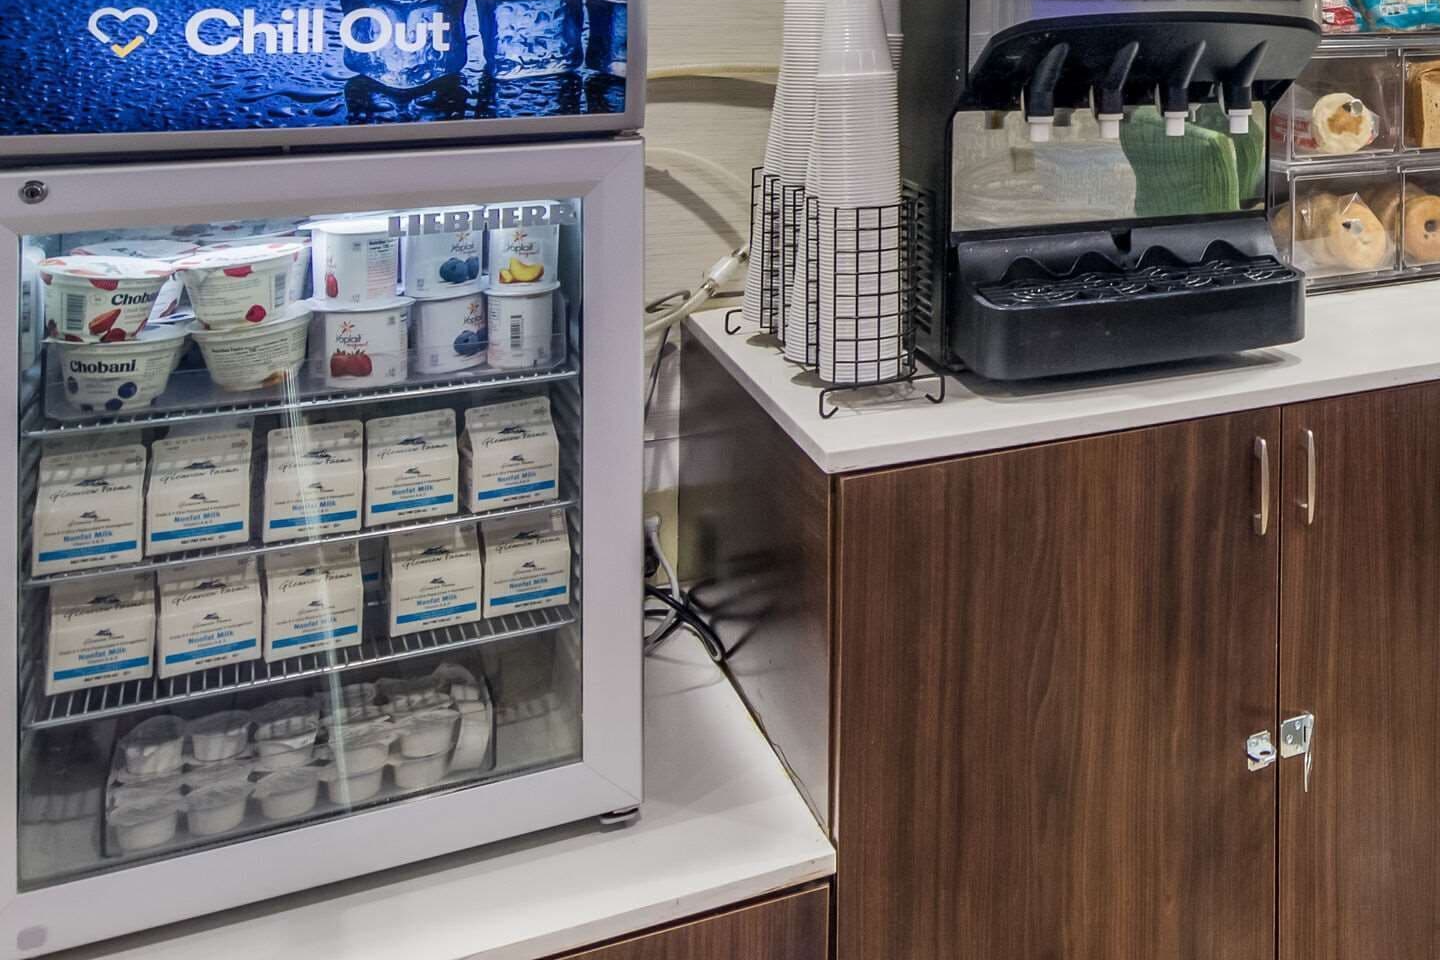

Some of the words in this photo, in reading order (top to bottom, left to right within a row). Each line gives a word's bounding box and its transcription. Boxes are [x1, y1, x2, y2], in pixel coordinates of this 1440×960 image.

[185, 7, 324, 56] Chill
[339, 7, 450, 53] Out
[388, 205, 577, 237] LIEBHERR
[70, 359, 137, 373] Chobani
